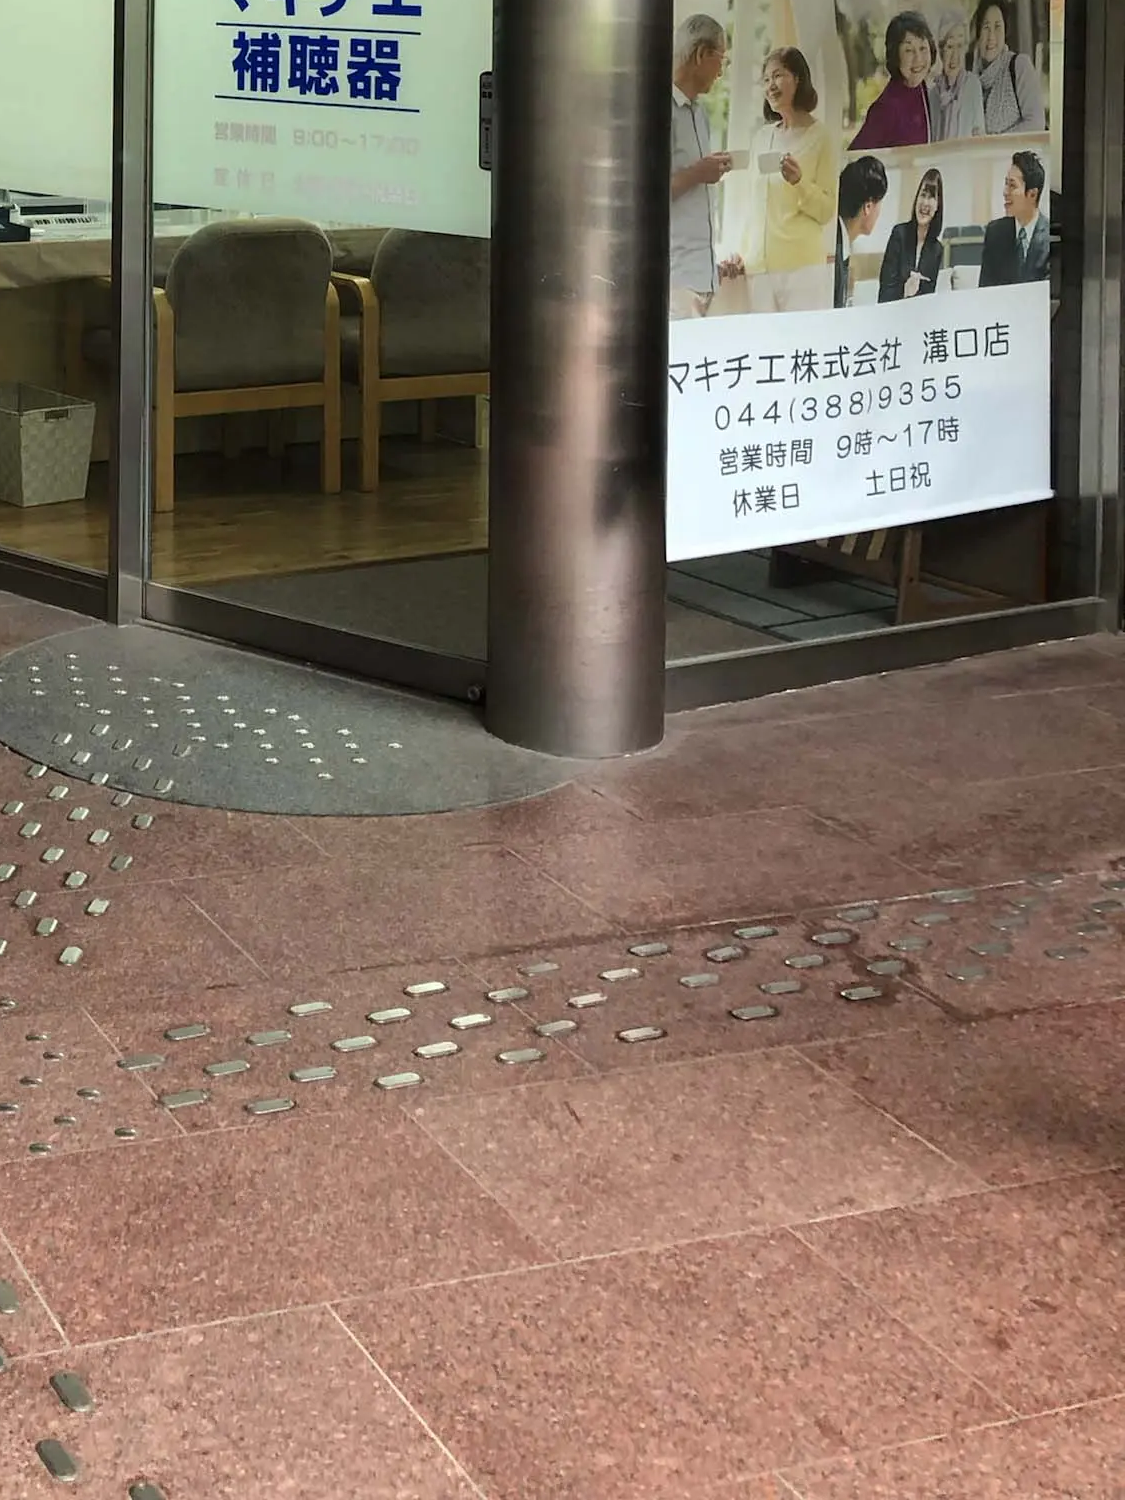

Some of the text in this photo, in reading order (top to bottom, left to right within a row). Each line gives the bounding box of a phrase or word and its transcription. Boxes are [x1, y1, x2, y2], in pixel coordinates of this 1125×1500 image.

[231, 30, 401, 101] 補聴器
[668, 322, 1011, 395] マキチエ株式会社 溝口店
[714, 374, 963, 431] 044(388)9355
[719, 437, 813, 477] 営業時間
[732, 461, 932, 518] 休業日 土日祝
